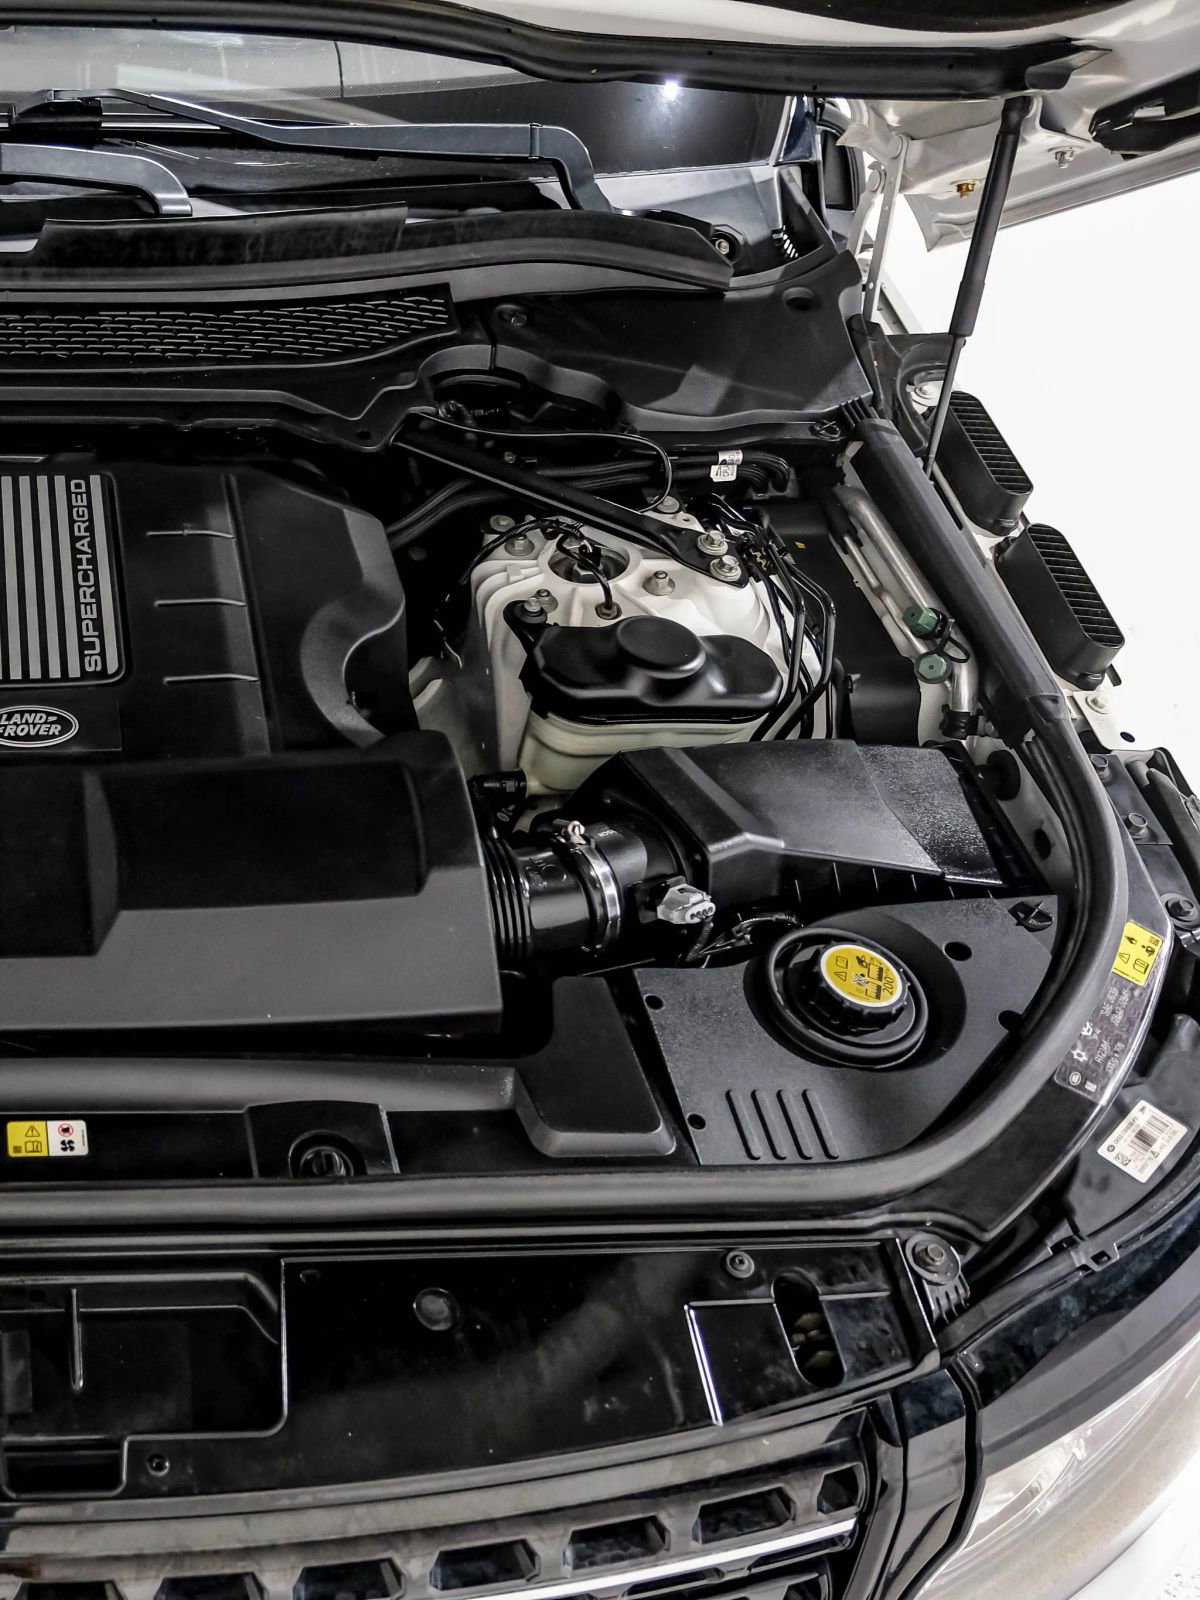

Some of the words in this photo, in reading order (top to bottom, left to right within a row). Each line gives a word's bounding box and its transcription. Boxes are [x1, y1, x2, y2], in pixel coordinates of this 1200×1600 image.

[70, 479, 102, 673] SUPERCHARGED
[0, 713, 46, 725] LAND
[3, 724, 62, 737] ROVER
[883, 976, 895, 996] 200
